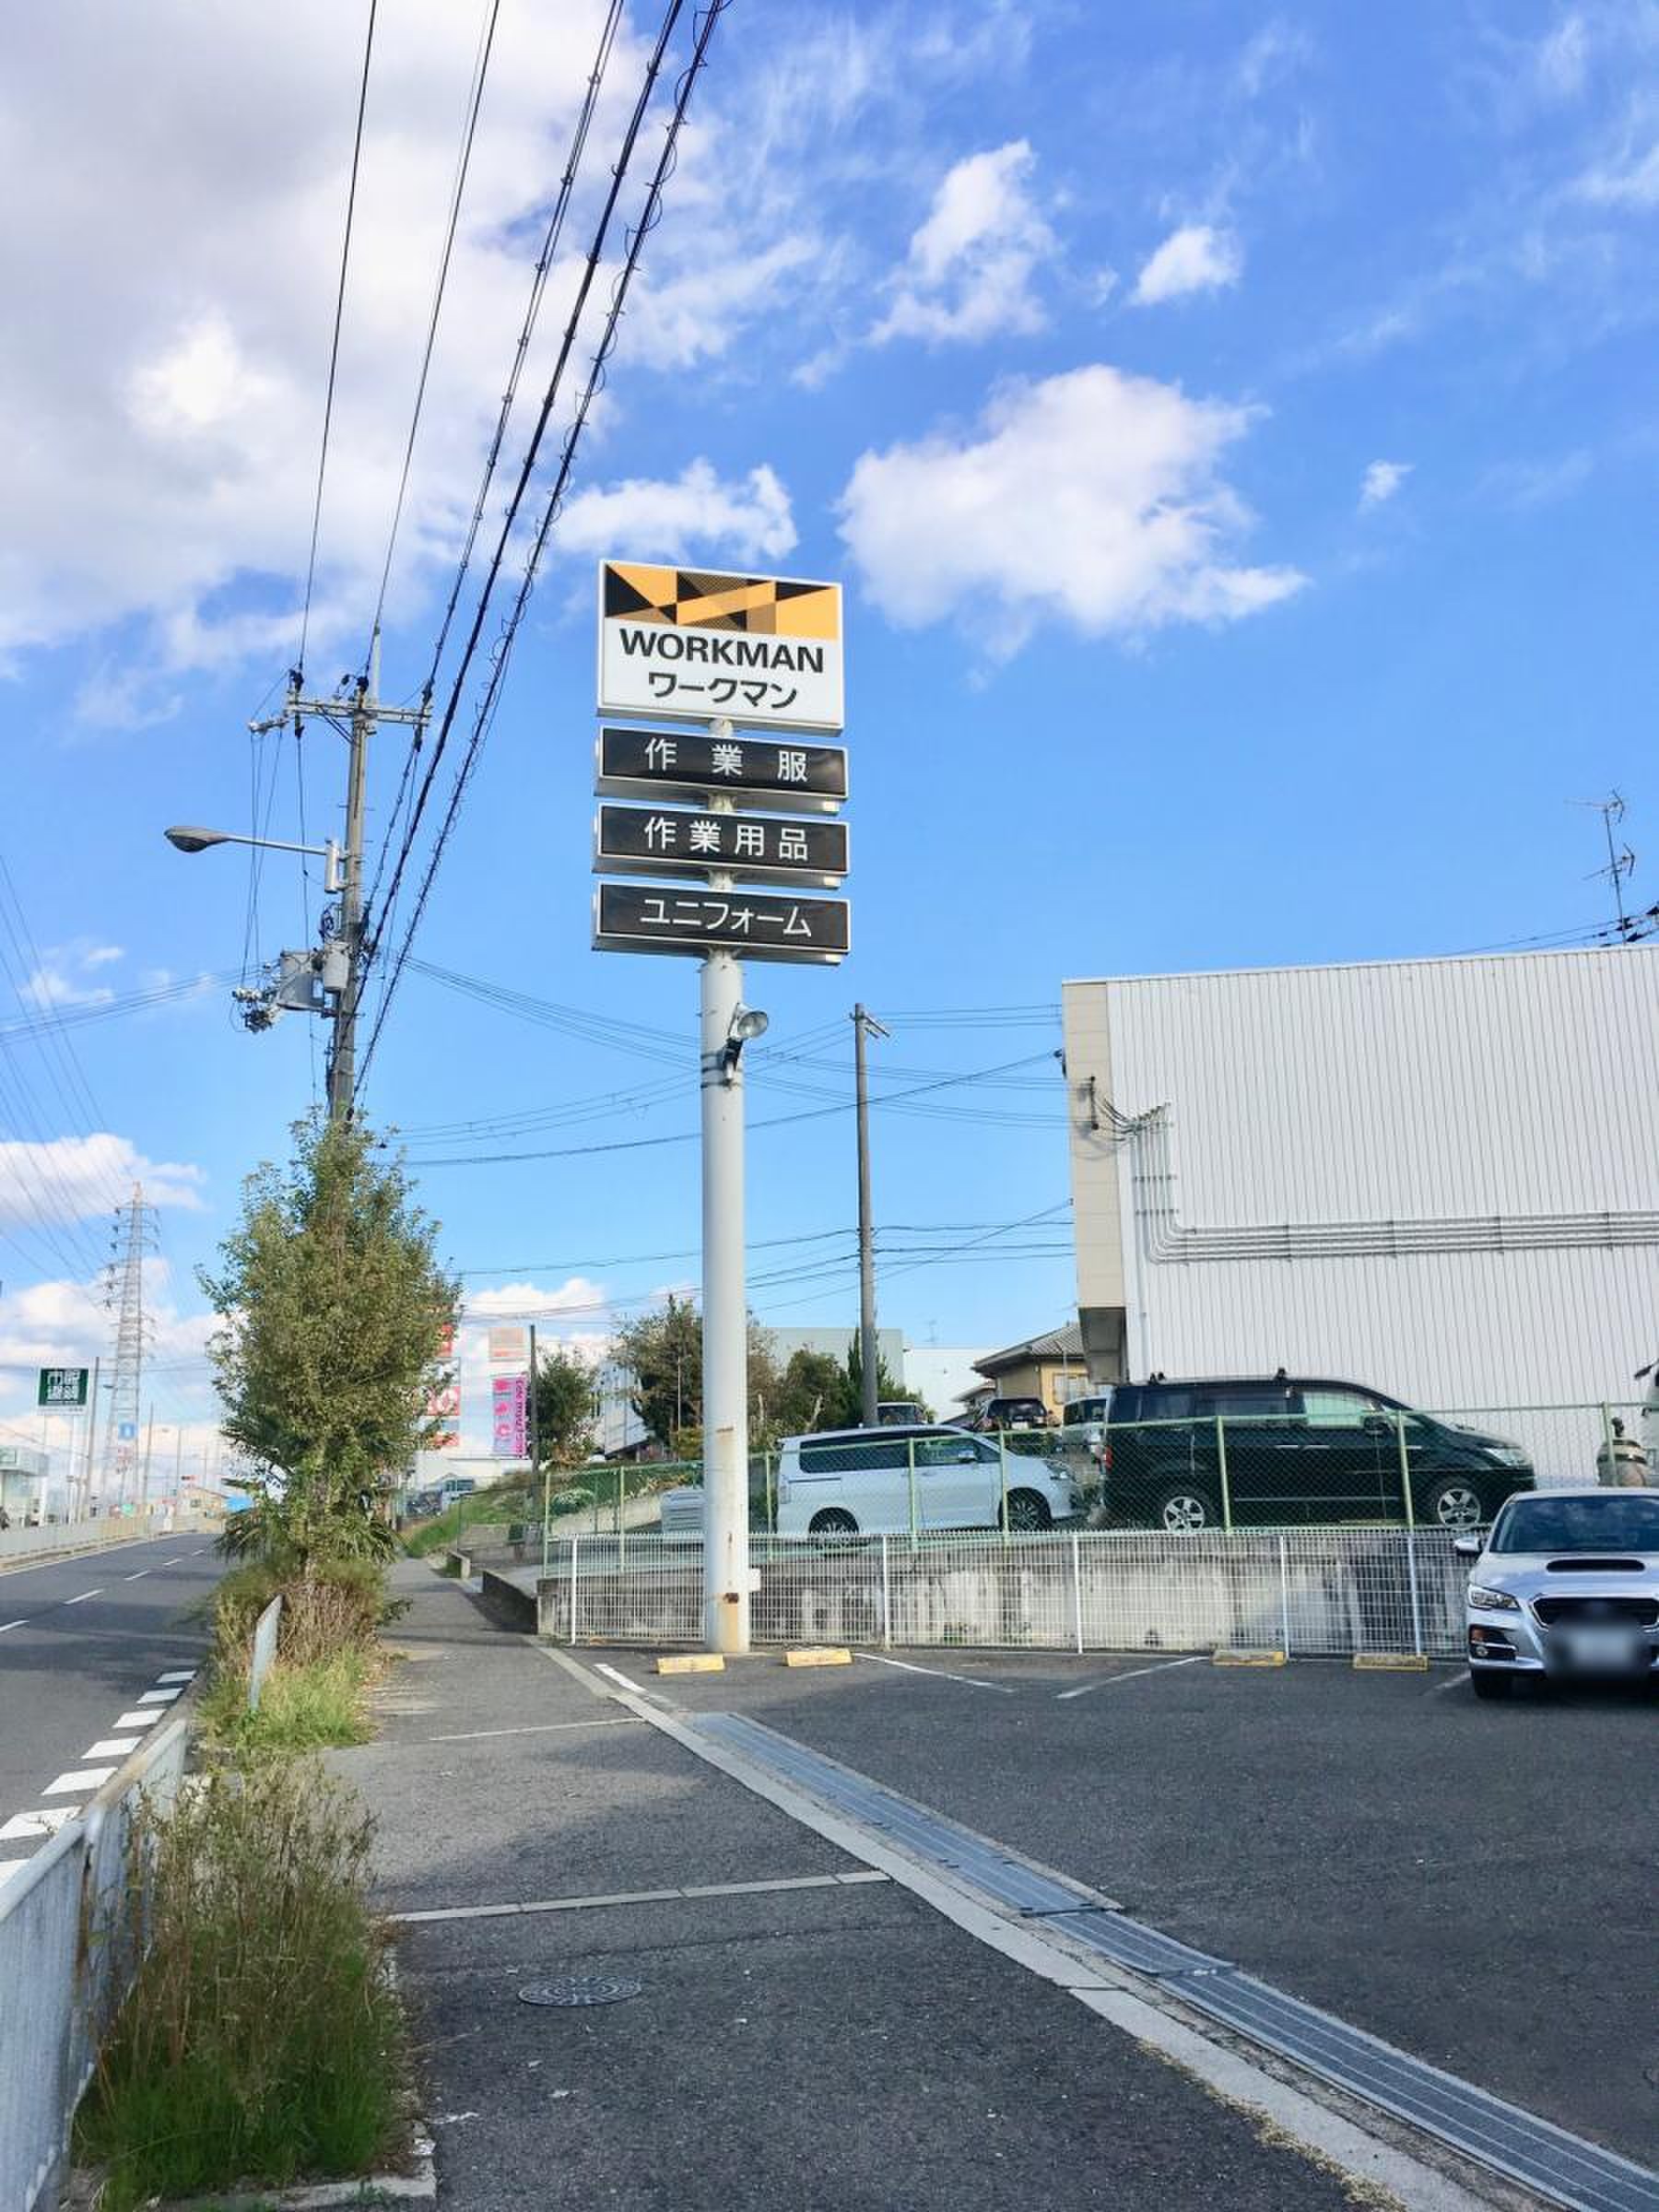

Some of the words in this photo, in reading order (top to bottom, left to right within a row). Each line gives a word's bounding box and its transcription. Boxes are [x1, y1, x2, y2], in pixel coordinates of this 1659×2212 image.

[619, 628, 824, 674] WORKMAN
[648, 672, 797, 709] ワークマン
[643, 816, 808, 861] 作業用品
[640, 898, 813, 938] ユニフォーム
